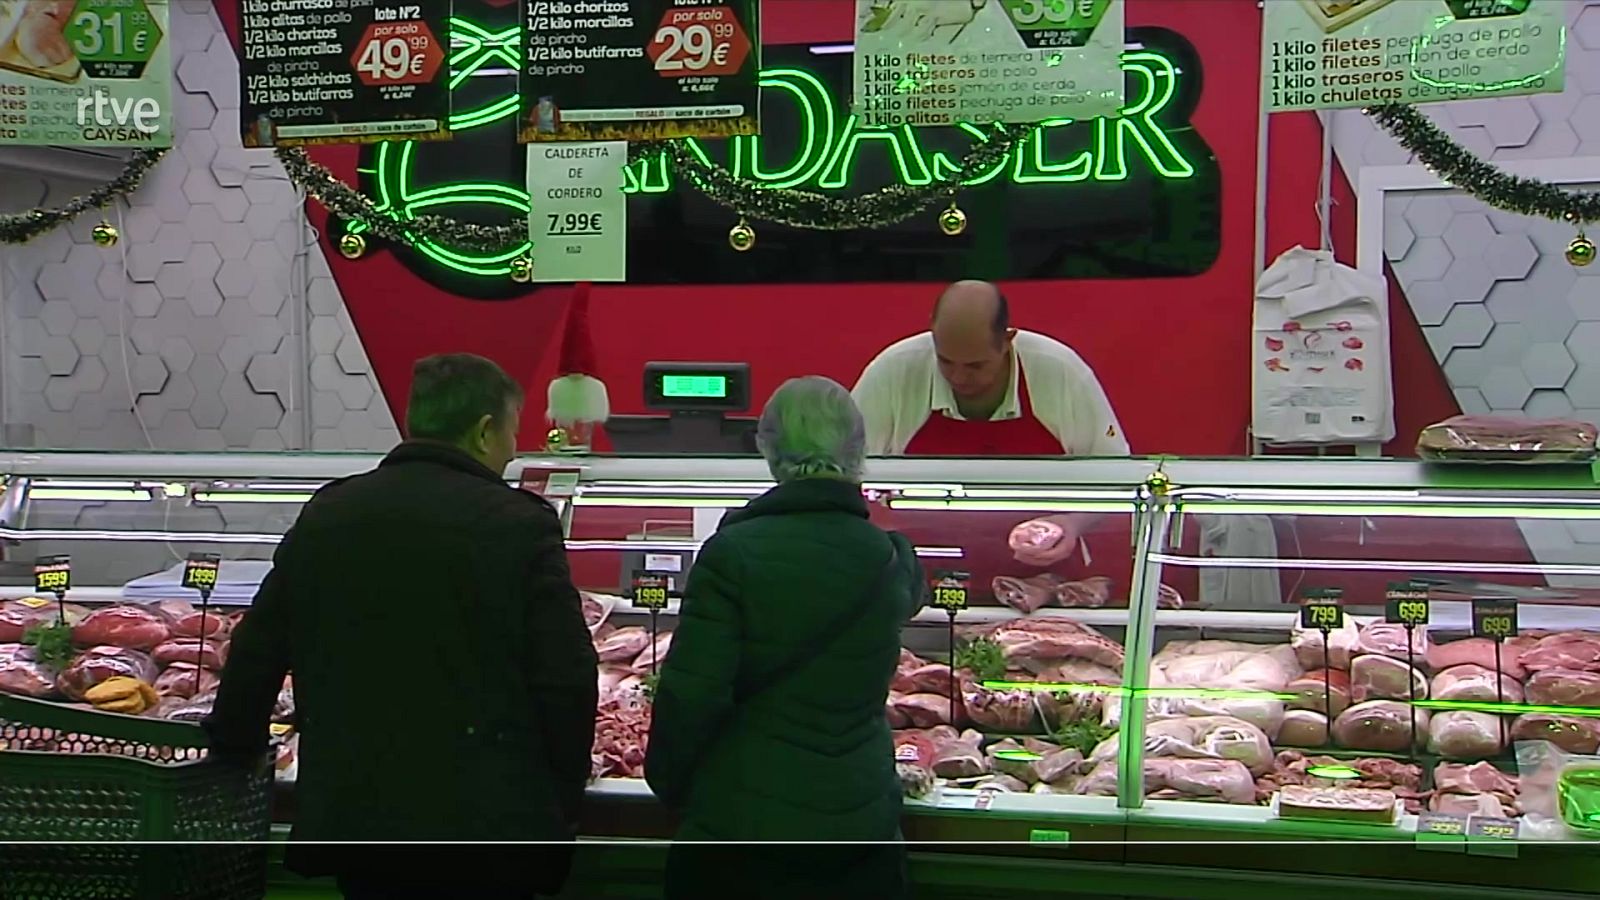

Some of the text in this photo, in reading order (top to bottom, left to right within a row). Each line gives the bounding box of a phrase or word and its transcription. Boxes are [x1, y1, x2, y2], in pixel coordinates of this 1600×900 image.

[250, 0, 268, 12] kilo
[271, 0, 333, 10] churrasco
[375, 7, 397, 20] lote
[527, 0, 629, 16] 1/2 kilo chorizos
[250, 14, 270, 27] kilo
[271, 13, 305, 26] alitas
[306, 13, 321, 24] de
[324, 11, 352, 25] pollo
[528, 17, 549, 31] 1/2
[550, 17, 572, 29] kilo
[673, 9, 722, 24] por solo
[74, 12, 123, 55] 31
[133, 31, 148, 52] €
[245, 26, 337, 44] 1/2 kilo chorizos
[374, 23, 418, 38] por solo
[530, 33, 587, 46] de pincho
[654, 24, 713, 70] 29
[713, 42, 730, 65] €
[1272, 42, 1280, 56] 1
[1284, 41, 1316, 55] kilo
[1321, 38, 1381, 52] filetes
[1386, 32, 1464, 49] pechuga
[1468, 30, 1492, 42] de
[246, 44, 265, 59] 1/2
[266, 44, 286, 57] kilo
[357, 38, 410, 79] 49
[410, 54, 426, 75] €
[528, 45, 643, 61] 1/2 kilo butifarras
[1272, 59, 1280, 73] 1
[1284, 57, 1316, 72] kilo
[1321, 55, 1381, 70] filetes
[1447, 48, 1470, 60] de
[1476, 43, 1530, 58] cerdo
[267, 60, 319, 74] de pincho
[864, 55, 871, 67] 1
[874, 54, 901, 67] kilo
[905, 53, 956, 65] filetes
[528, 63, 585, 76] de pincho
[864, 69, 871, 82] 1
[874, 69, 901, 81] kilo
[1272, 75, 1280, 90] 1
[1284, 74, 1316, 89] kilo
[1321, 70, 1405, 87] traseros
[1439, 64, 1481, 79] pollo
[247, 71, 352, 89] 1/2 kilo salchichas
[1, 84, 26, 96] tes
[248, 87, 354, 105] 1/2 kilo butifarras
[864, 84, 871, 96] 1
[874, 83, 900, 96] kilo
[1272, 92, 1280, 106] 1
[1284, 91, 1316, 105] kilo
[1320, 86, 1403, 103] chuletas
[1408, 85, 1431, 97] de
[1, 99, 27, 110] tes
[864, 99, 871, 110] 1
[874, 98, 901, 110] kilo
[905, 97, 957, 109] filetes
[1027, 96, 1045, 106] de
[1, 113, 27, 124] tes
[269, 106, 324, 119] de pincho
[864, 112, 871, 125] 1
[874, 112, 901, 125] kilo
[905, 111, 950, 124] alitas
[1, 127, 17, 139] ta
[545, 147, 609, 159] CALDERETA
[568, 168, 583, 179] DE
[547, 187, 602, 199] CORDERO
[547, 213, 602, 233] 7,99€
[38, 571, 67, 587] 1599
[189, 568, 216, 583] 1999
[635, 588, 665, 604] 1999
[934, 588, 966, 605] 1399
[1310, 606, 1337, 622] 799
[1399, 602, 1426, 619] 699
[1482, 617, 1510, 633] 699
